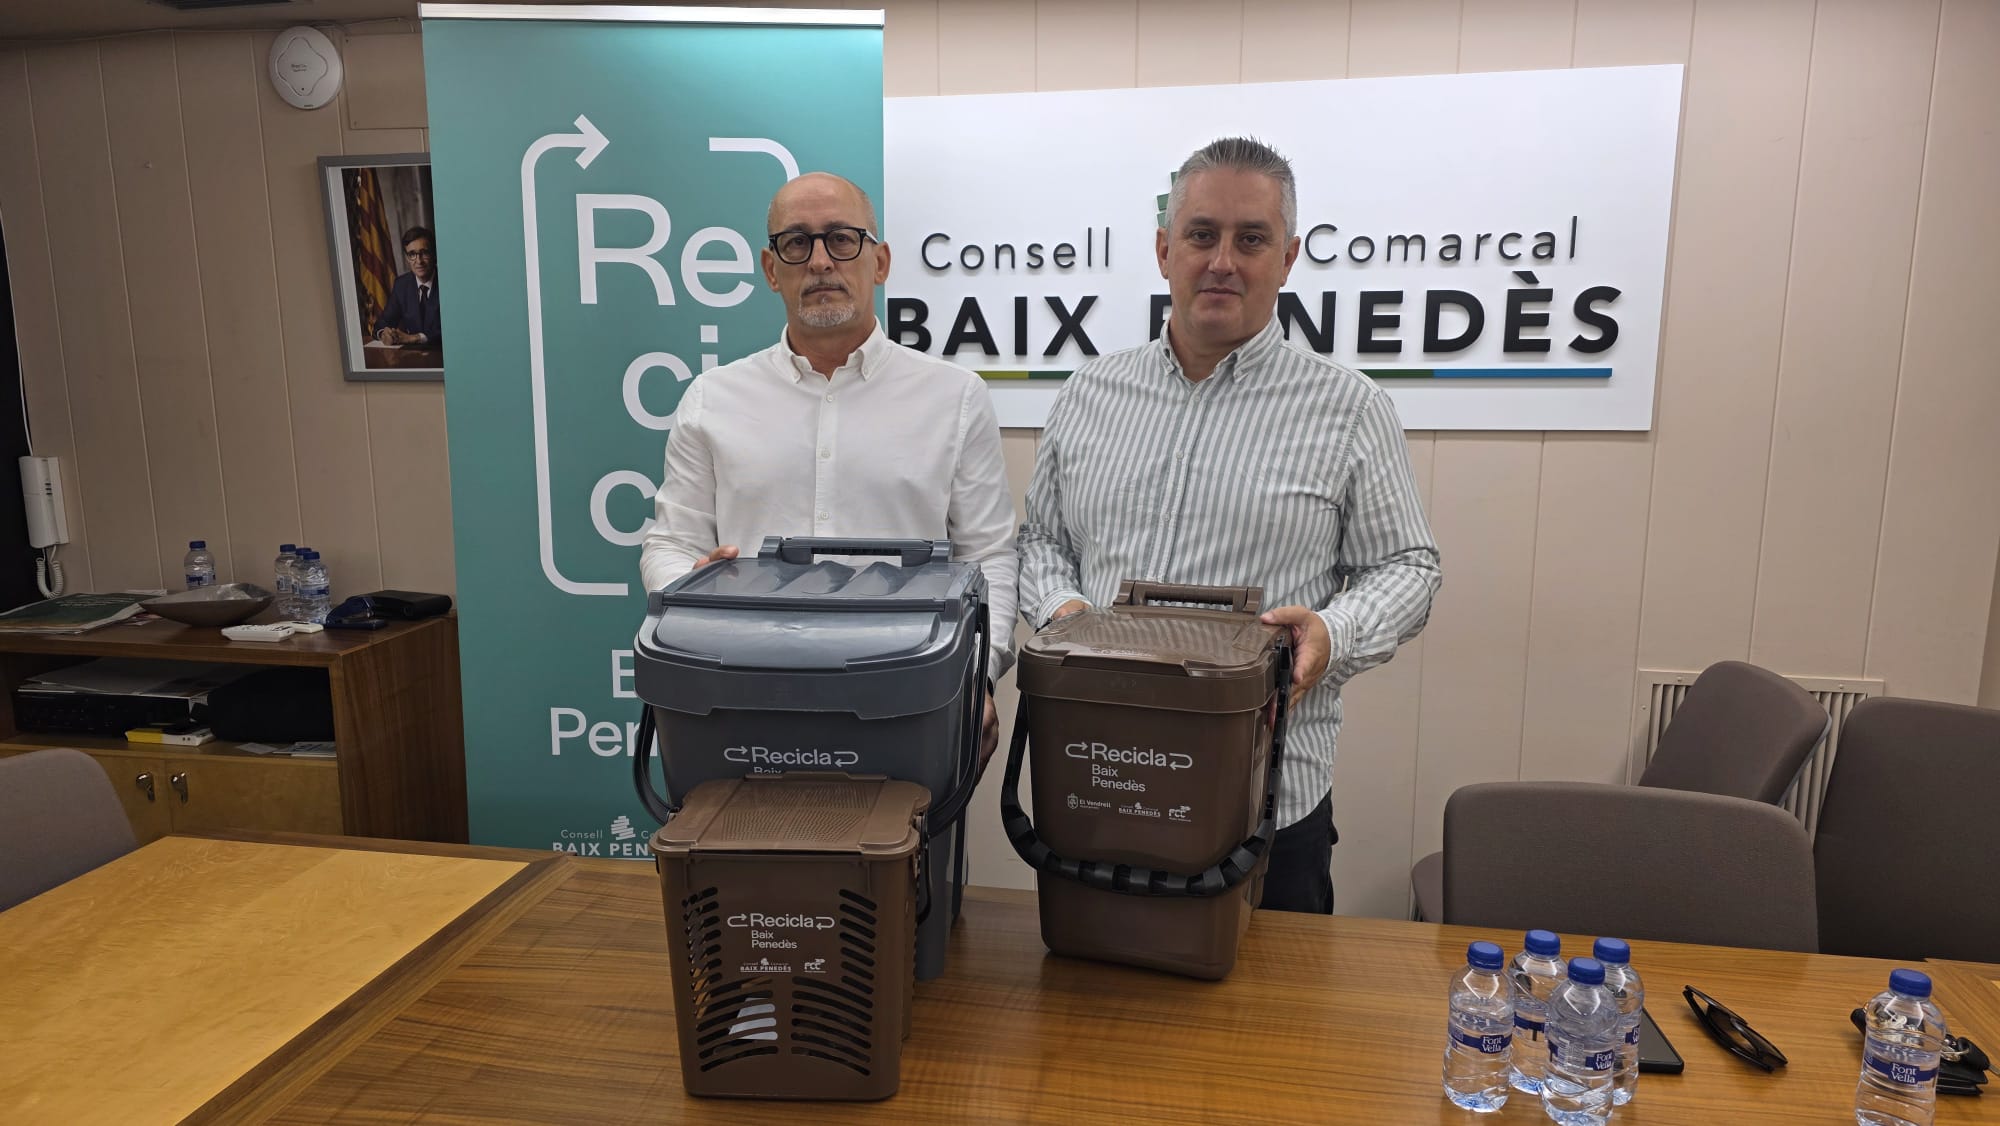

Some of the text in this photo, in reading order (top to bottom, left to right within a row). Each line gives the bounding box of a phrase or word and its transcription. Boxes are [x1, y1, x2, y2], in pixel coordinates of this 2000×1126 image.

[920, 215, 1578, 271] Consell Comarcal
[575, 193, 755, 308] Re
[886, 270, 1623, 356] BAIX NEDÈS
[751, 746, 832, 765] Recicla
[1091, 742, 1167, 767] Recicla
[1092, 764, 1119, 777] Baix
[1092, 776, 1146, 792] Penedès
[560, 829, 603, 839] Consell
[750, 913, 814, 928] Recicla
[751, 930, 774, 939] Baix
[751, 939, 798, 949] Penedès
[1482, 1036, 1502, 1045] Font
[1482, 1043, 1502, 1052] Vella
[1892, 1063, 1917, 1076] Font
[1891, 1071, 1916, 1083] Vella
